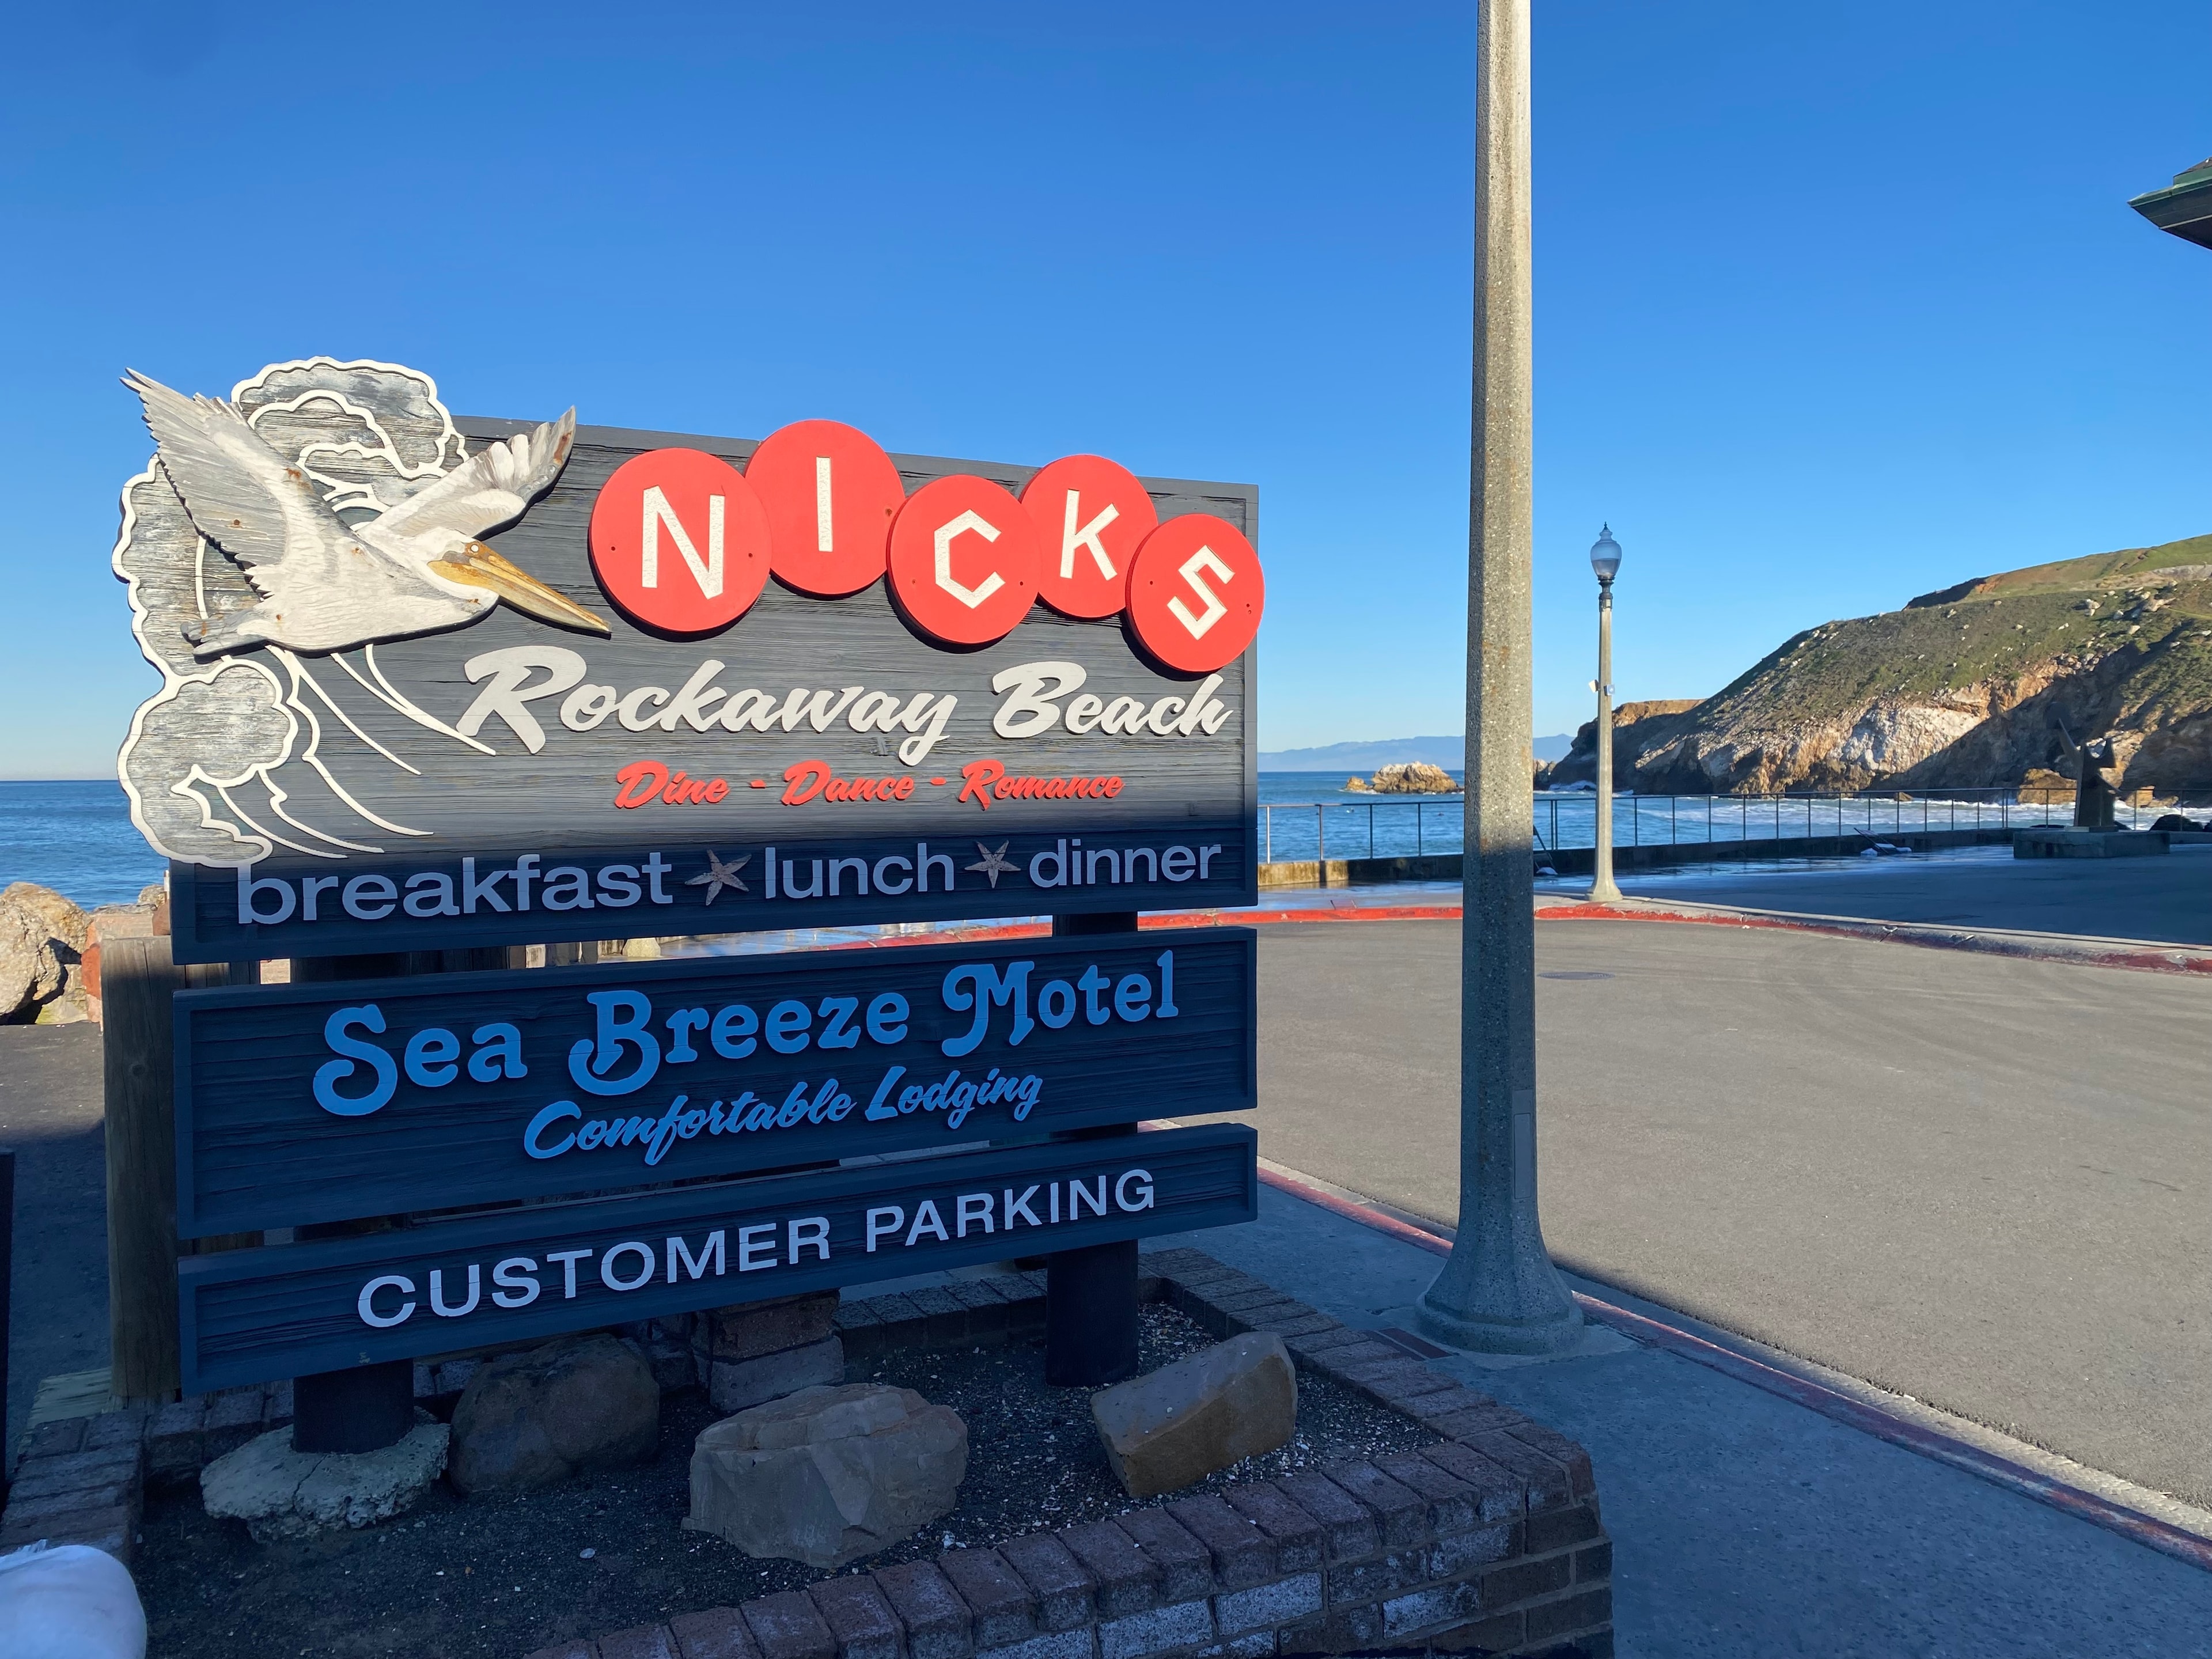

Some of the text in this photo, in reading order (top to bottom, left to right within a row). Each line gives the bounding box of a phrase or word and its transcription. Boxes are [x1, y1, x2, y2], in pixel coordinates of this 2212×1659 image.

[642, 457, 1236, 641] NICKS
[456, 645, 1235, 767] Rockaway Beach
[615, 760, 730, 809] Dine
[781, 760, 915, 806] Dance
[959, 759, 1126, 810] Romance
[237, 838, 1222, 925] breakfast lunch dinner
[312, 950, 1179, 1116] Sea Breeze Motel
[523, 1065, 1043, 1166] Comfortable Lodging
[357, 1169, 1156, 1328] CUSTOMER PARKING
